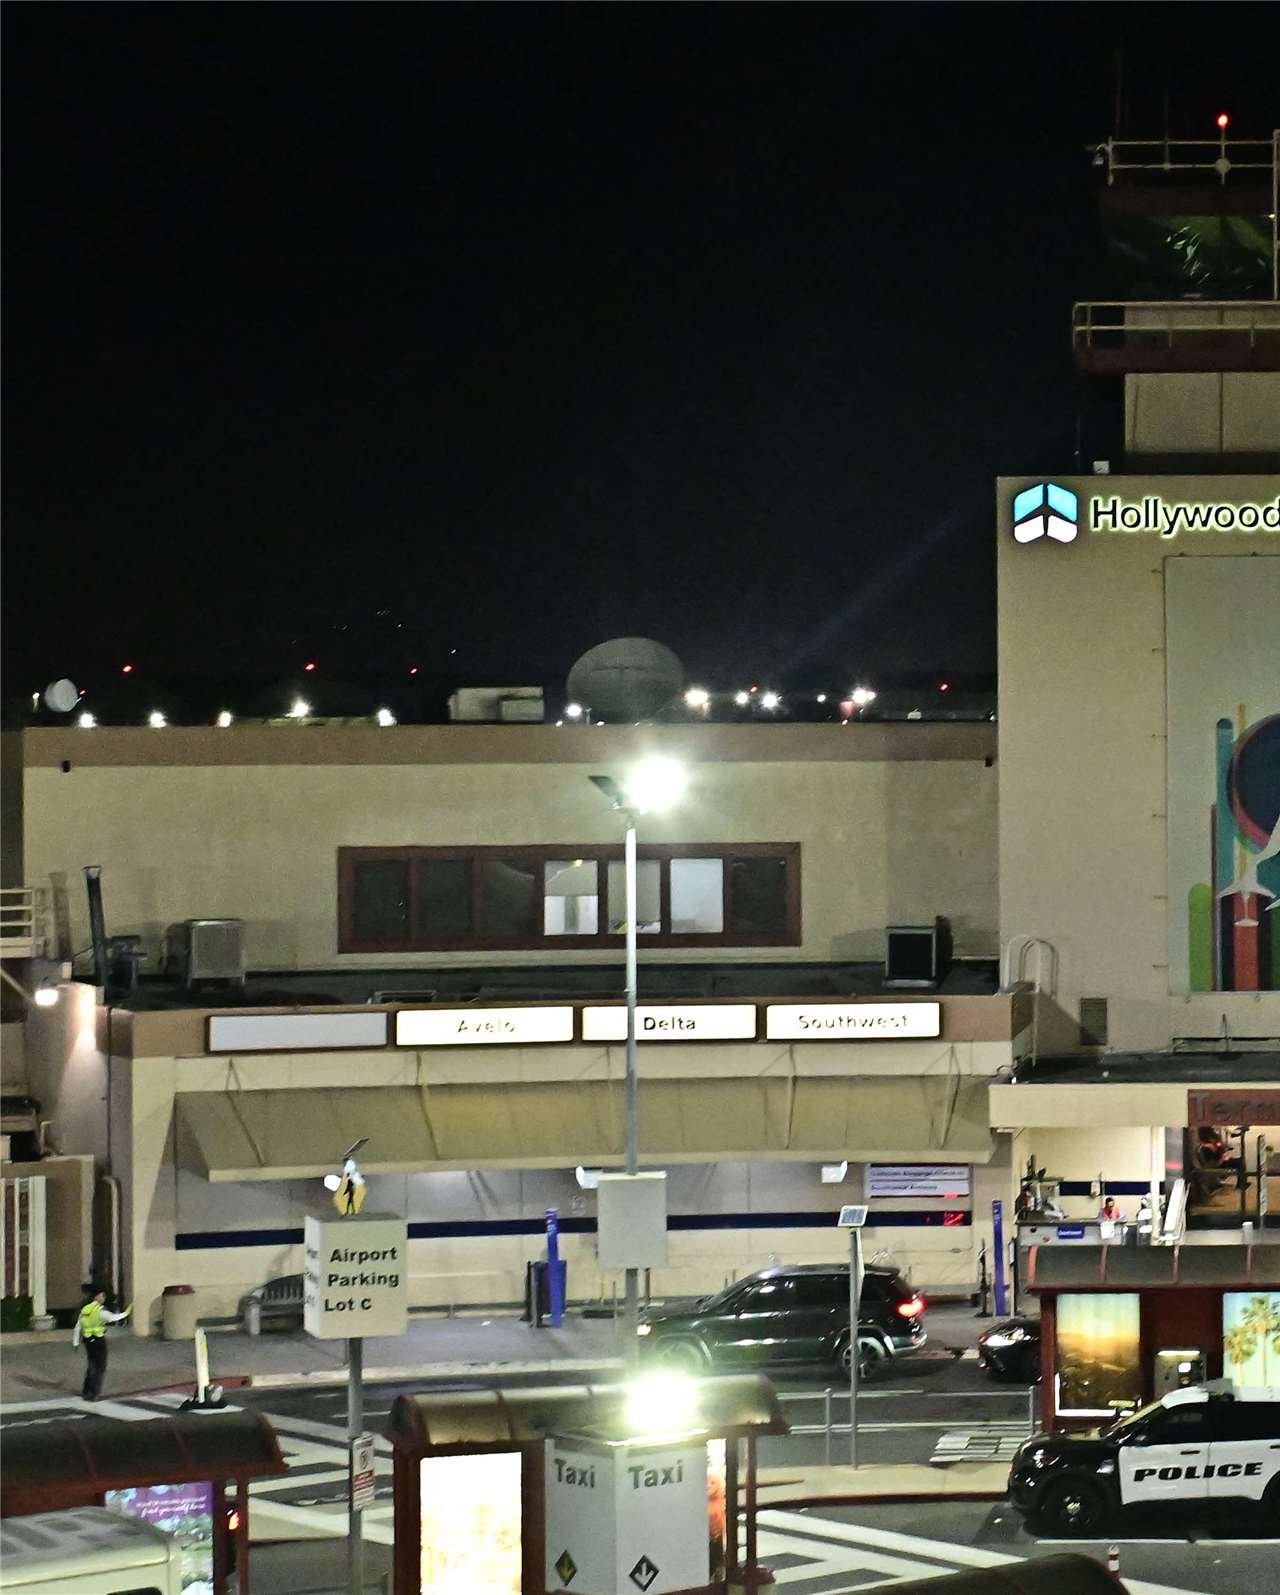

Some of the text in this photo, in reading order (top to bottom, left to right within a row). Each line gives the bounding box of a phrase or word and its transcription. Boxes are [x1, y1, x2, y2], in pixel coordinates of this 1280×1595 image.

[457, 1017, 517, 1034] Avelo
[643, 1015, 697, 1031] Delta
[797, 1013, 909, 1030] Southwest
[329, 1246, 398, 1265] Airport
[327, 1271, 400, 1288] Parking
[324, 1296, 372, 1312] Lot C
[554, 1457, 596, 1488] Taxi
[627, 1458, 684, 1489] Taxi
[1133, 1461, 1263, 1482] POLICE
